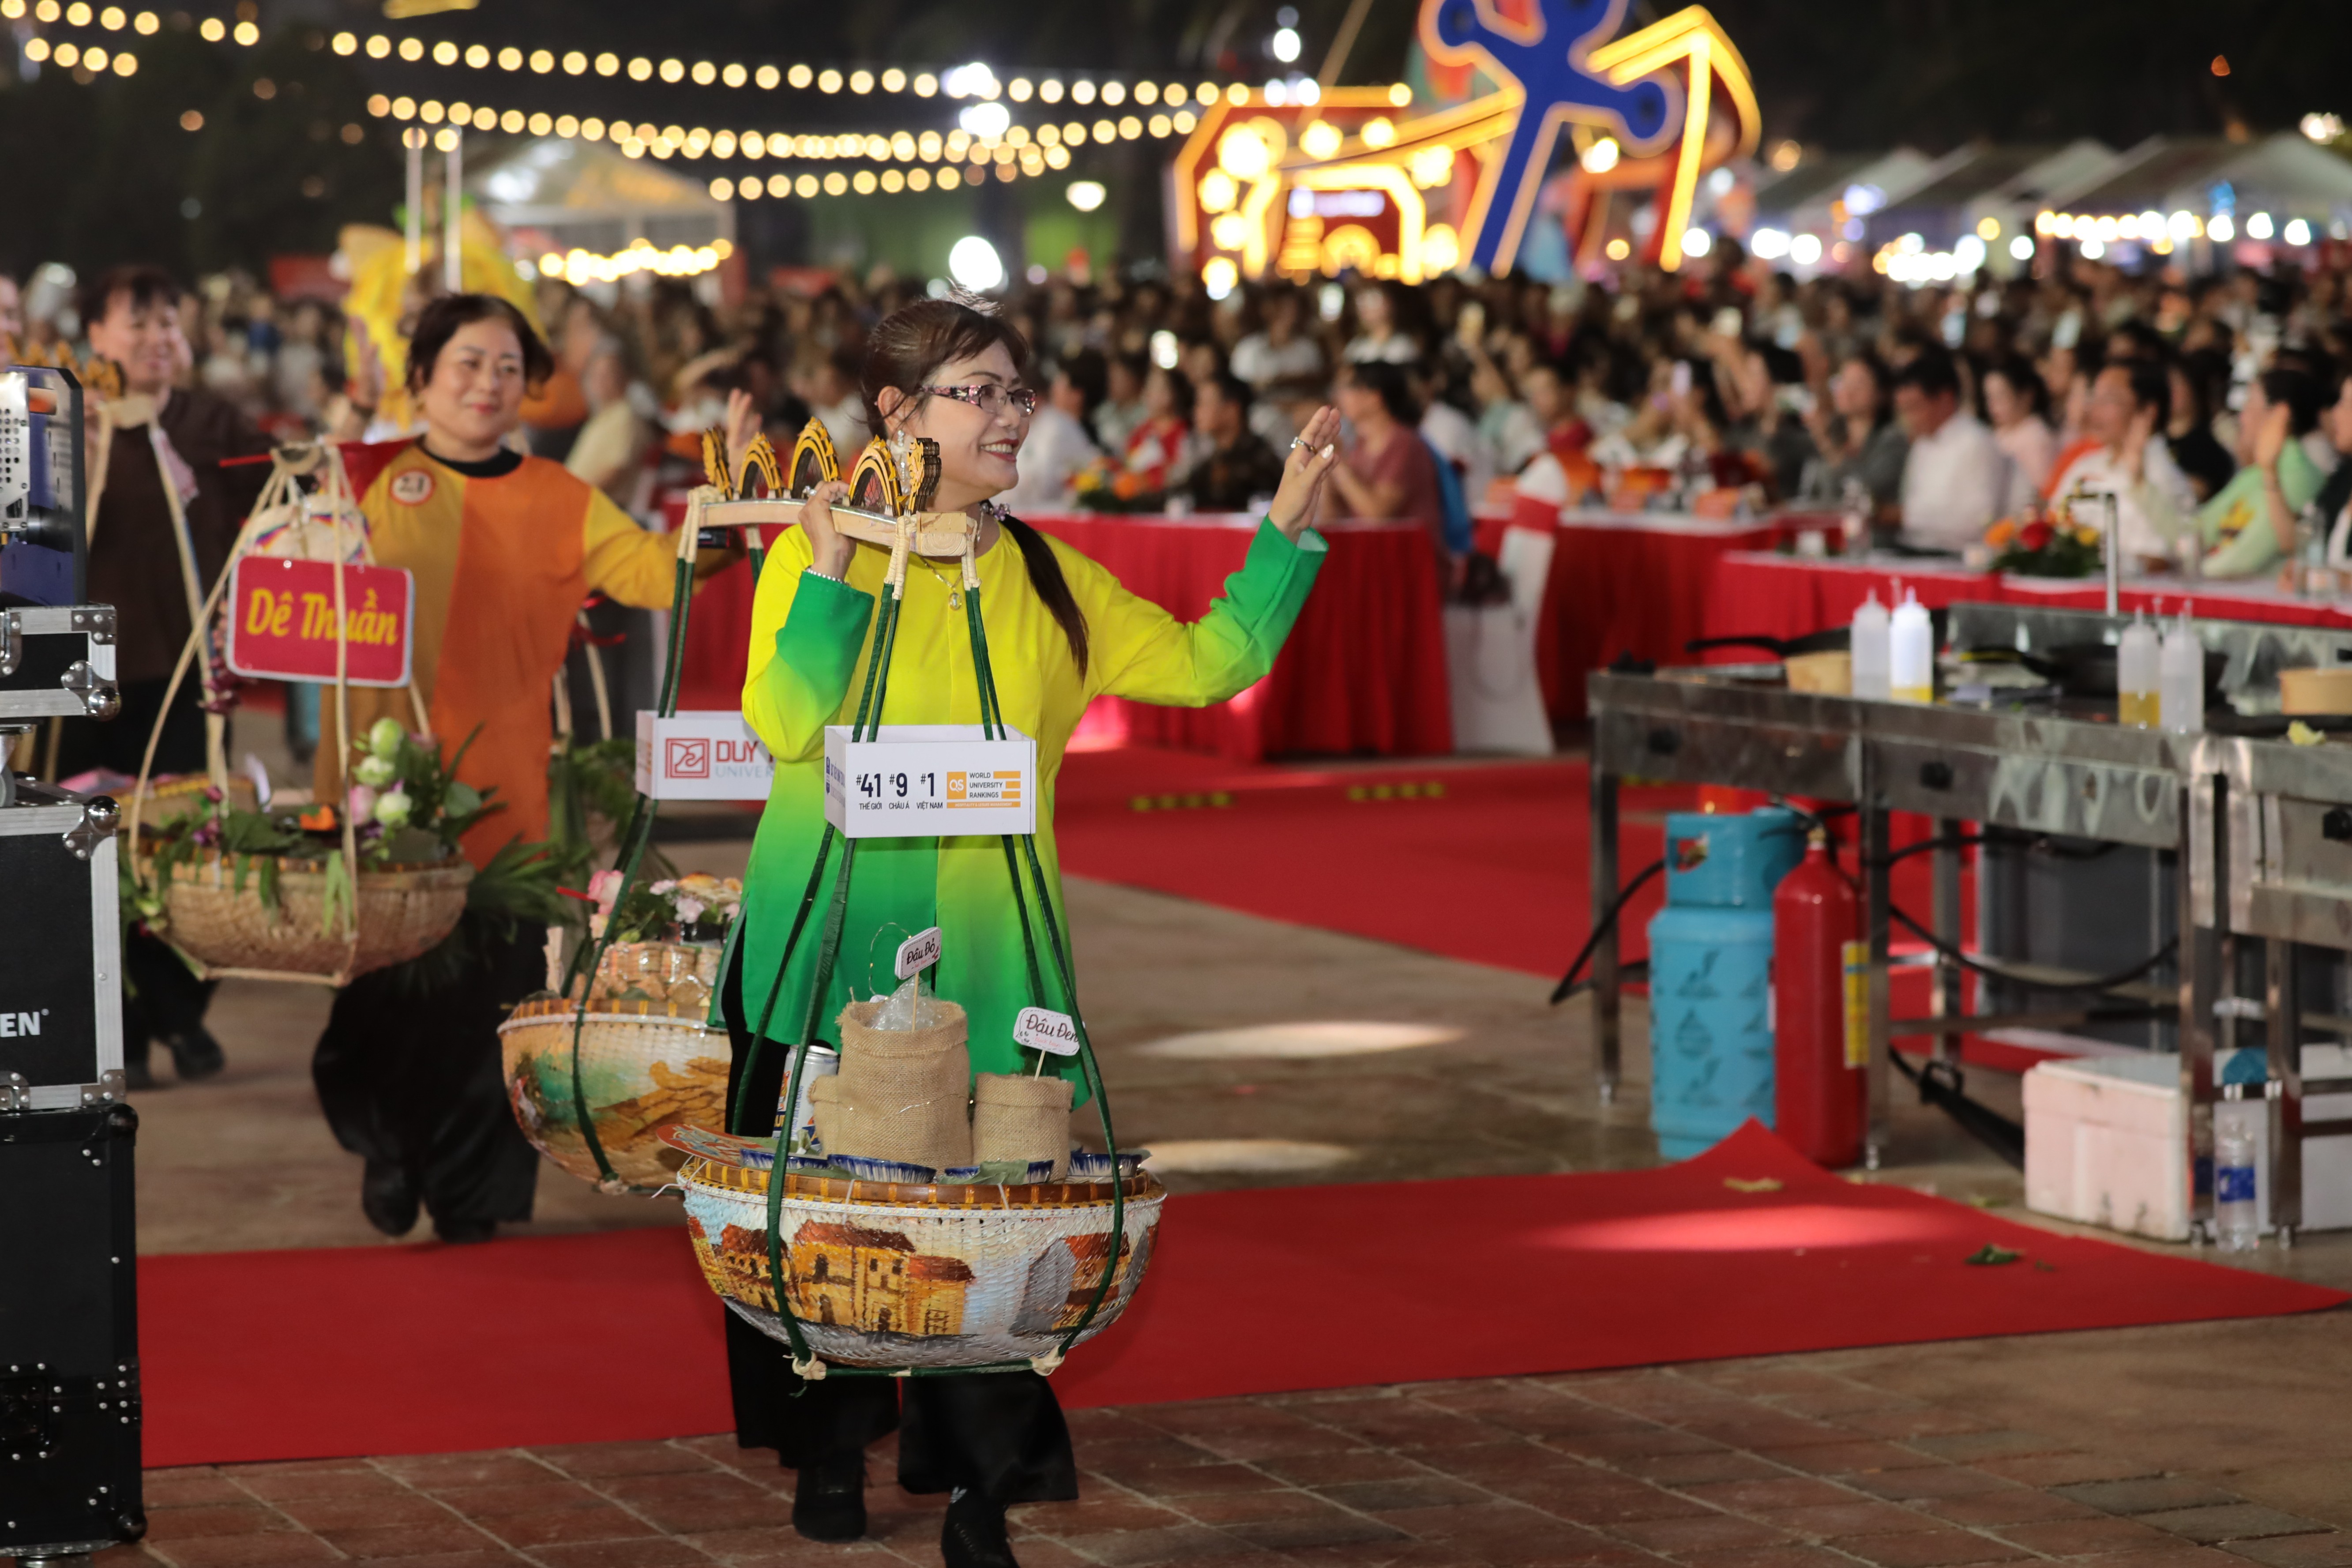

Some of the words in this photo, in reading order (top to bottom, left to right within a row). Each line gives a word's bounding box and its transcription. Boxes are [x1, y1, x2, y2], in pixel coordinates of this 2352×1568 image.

[246, 587, 294, 637] Dê
[716, 740, 759, 763] DUY
[856, 773, 881, 797] #41
[889, 772, 908, 797] #9
[921, 773, 934, 797] #1
[949, 779, 964, 793] QS
[859, 801, 870, 810] THẾ
[871, 801, 882, 810] GIỚI
[905, 801, 909, 809] Á
[917, 801, 929, 810] VIỆT
[1026, 1014, 1055, 1037] Đậu
[1057, 1023, 1078, 1042] Đen
